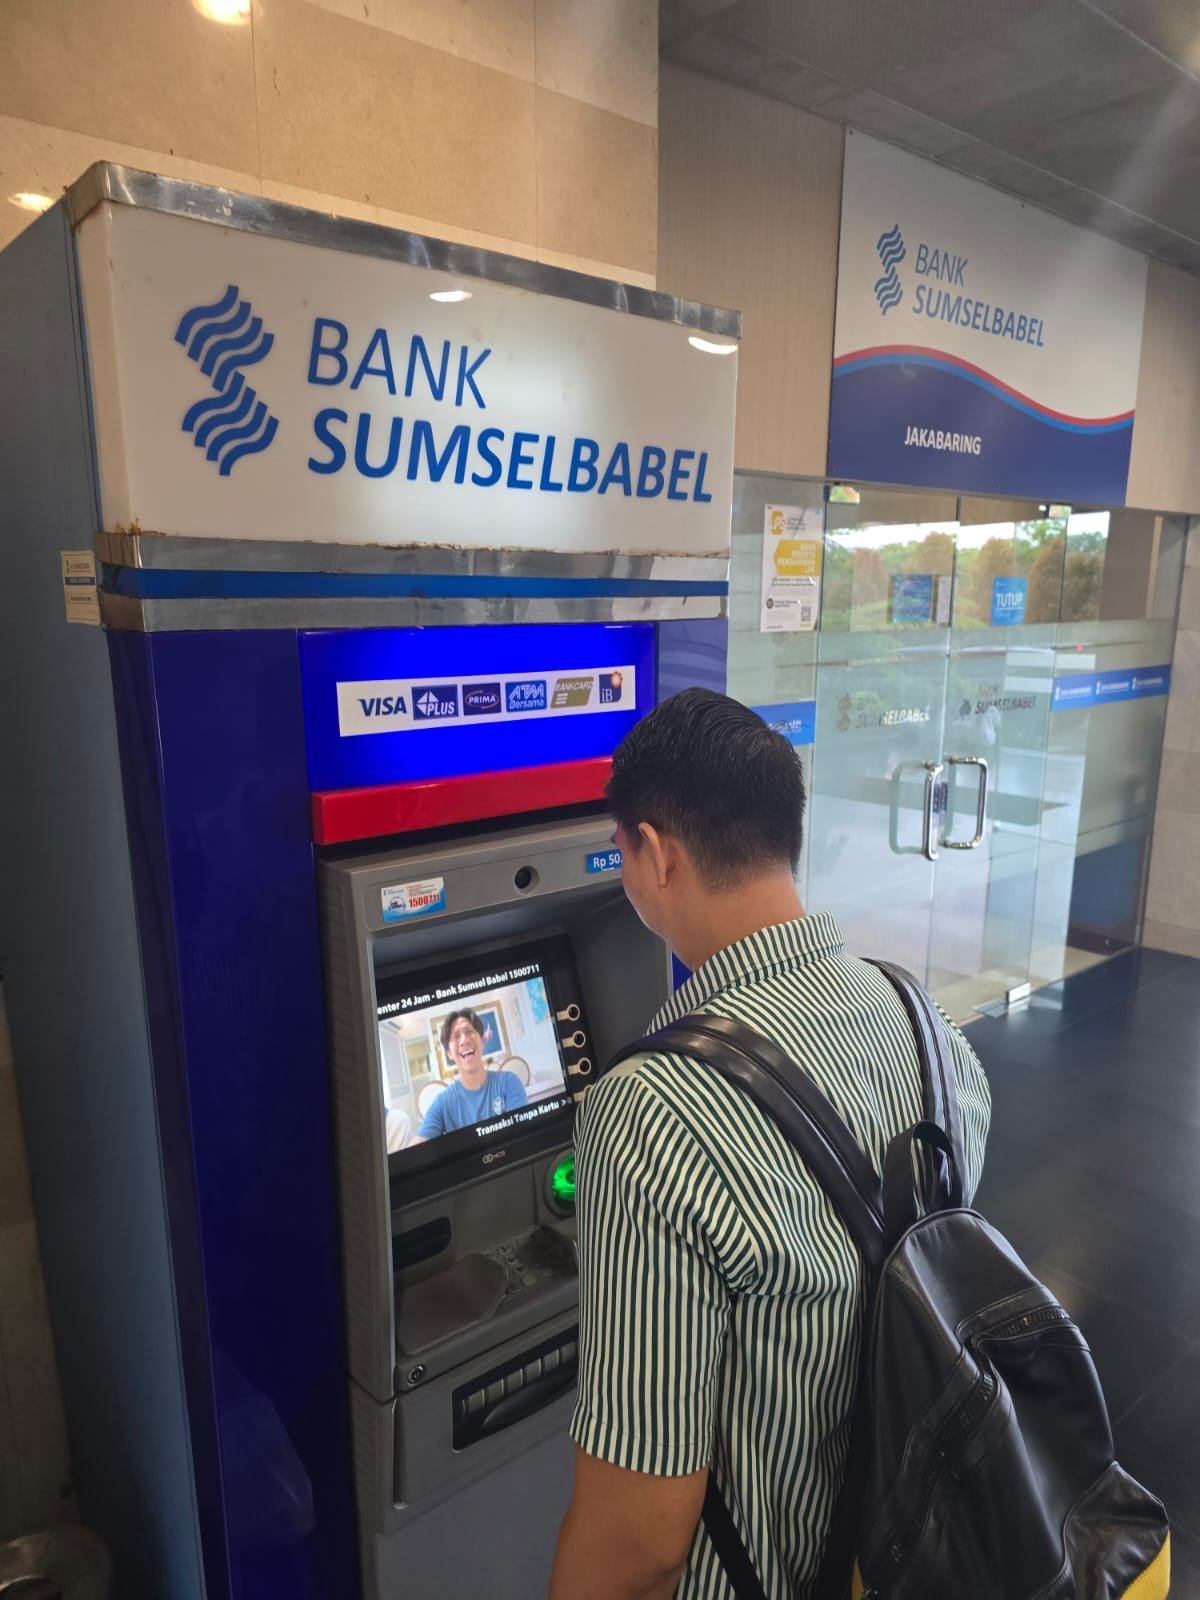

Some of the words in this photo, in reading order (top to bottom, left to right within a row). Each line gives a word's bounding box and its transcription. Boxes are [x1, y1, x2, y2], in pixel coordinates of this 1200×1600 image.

[915, 243, 969, 287] BANK
[912, 284, 1045, 347] SUMSELBABEL
[307, 317, 492, 409] BANK
[307, 407, 713, 503] SUMSELBABEL
[904, 425, 982, 455] JAKABARING
[996, 592, 1024, 608] TUTUP
[357, 696, 408, 717] VISA
[426, 701, 456, 716] PLUS
[468, 695, 496, 705] PRIMA
[509, 683, 545, 700] ATM
[602, 688, 613, 702] iB
[509, 699, 545, 710] Bersama
[593, 857, 607, 871] Rp
[408, 893, 440, 908] 1500711
[401, 998, 413, 1009] 24
[413, 994, 431, 1006] Jam
[435, 985, 458, 999] Bank
[457, 977, 486, 994] Sumsel
[486, 971, 509, 987] Babel
[508, 963, 540, 980] 1500711
[475, 1116, 514, 1137] Transaksi
[513, 1109, 539, 1122] Tanpa
[538, 1100, 560, 1115] Kartu
